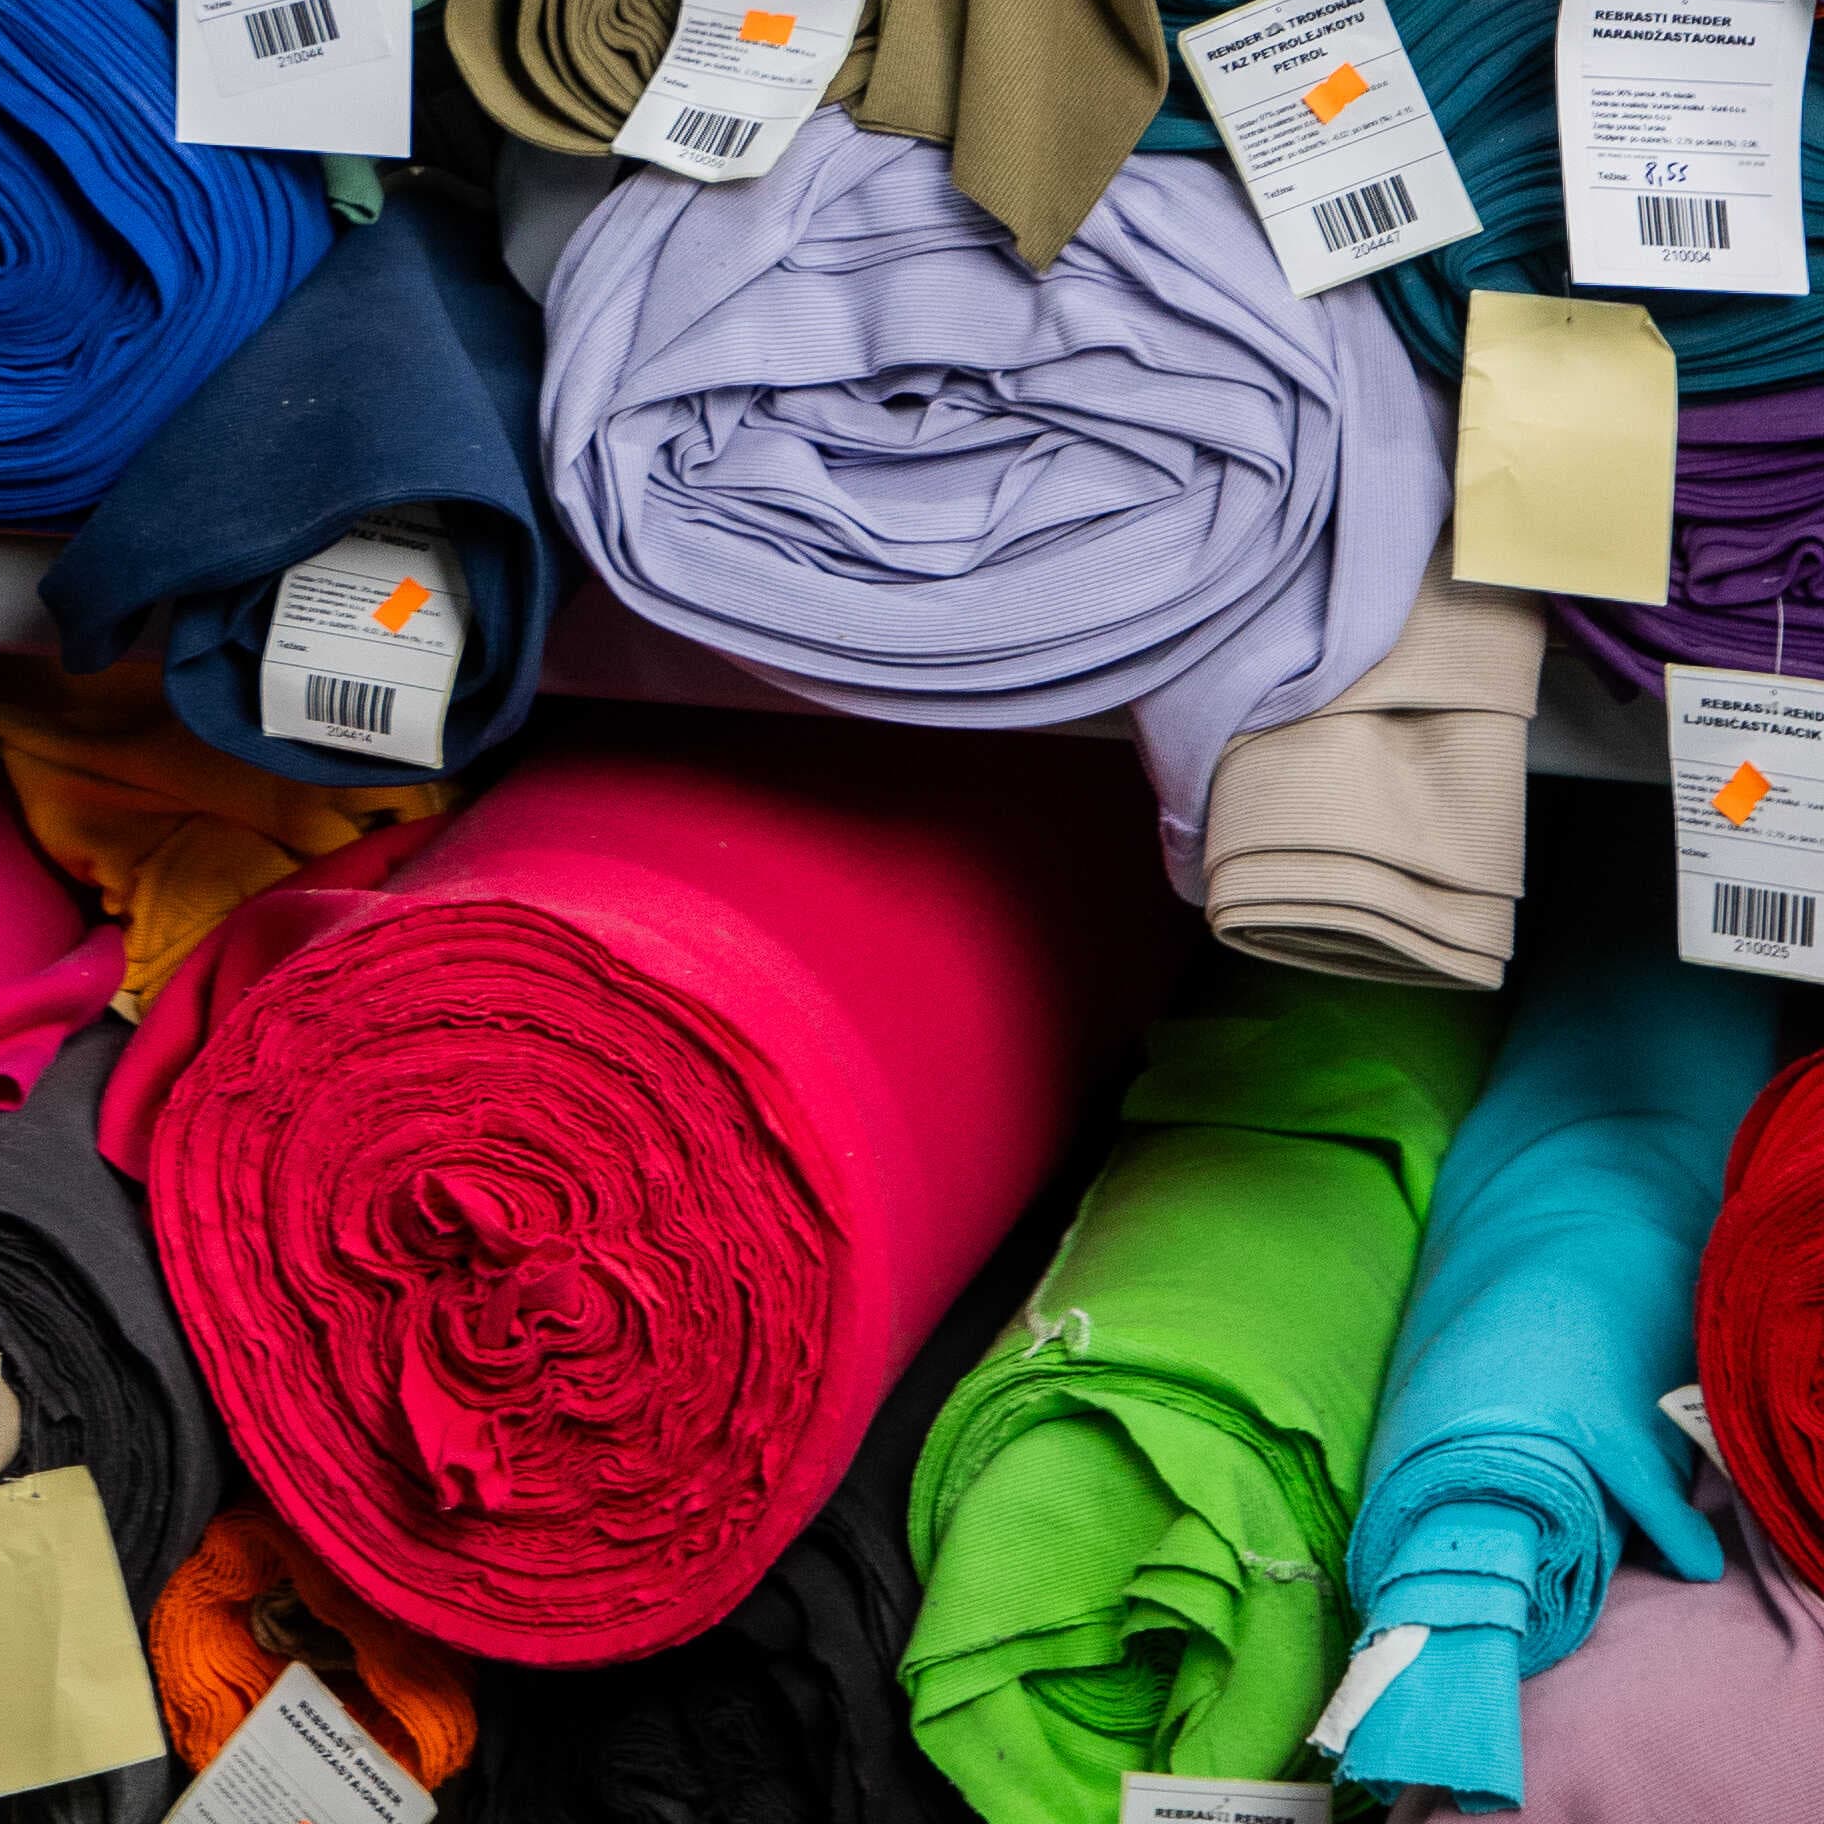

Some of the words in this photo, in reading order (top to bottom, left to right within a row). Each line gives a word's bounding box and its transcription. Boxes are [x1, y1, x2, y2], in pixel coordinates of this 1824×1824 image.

[1594, 9, 1669, 25] REBRASTI
[1671, 13, 1733, 28] RENDER
[1207, 28, 1263, 62] RENDER
[1592, 26, 1757, 48] NARANDŽASTA/ORANJ
[1220, 54, 1250, 75] YAZ
[1272, 47, 1329, 75] PETROL
